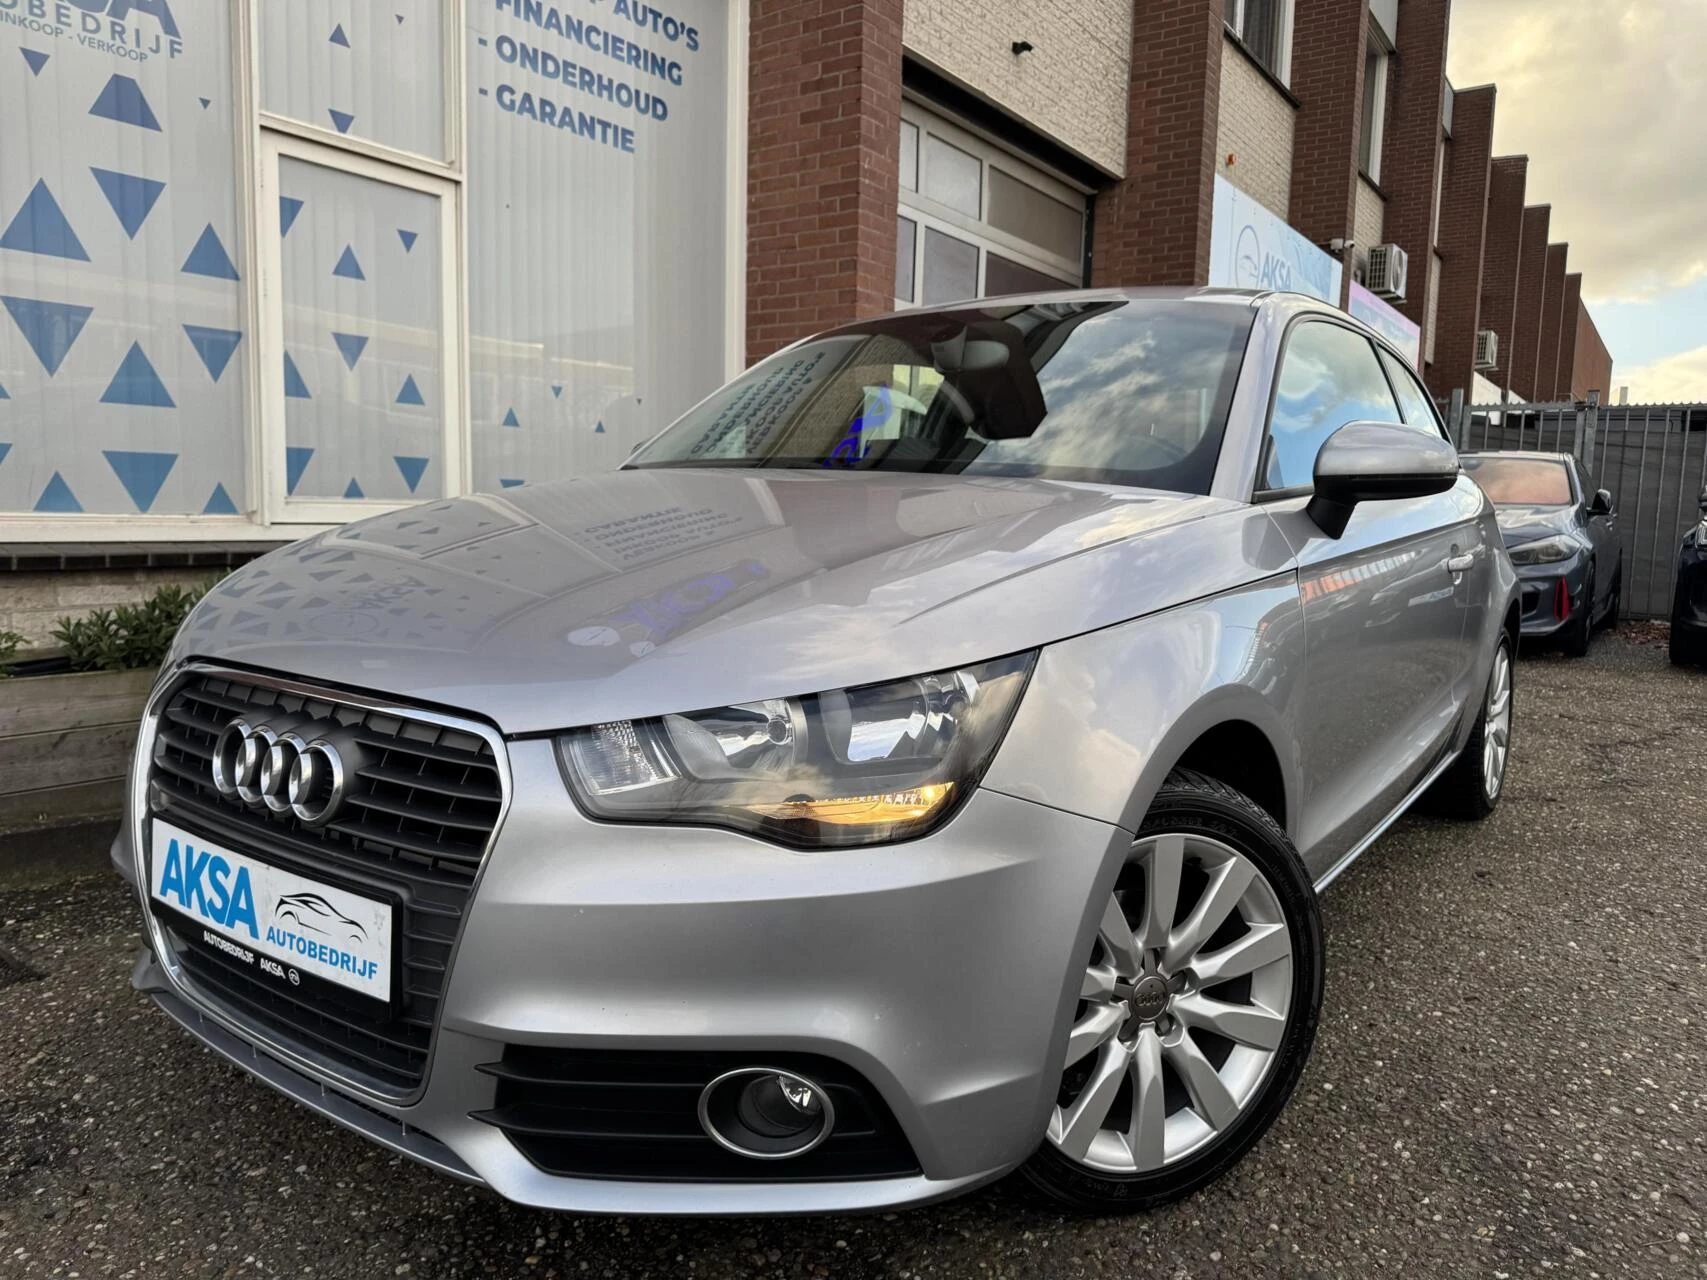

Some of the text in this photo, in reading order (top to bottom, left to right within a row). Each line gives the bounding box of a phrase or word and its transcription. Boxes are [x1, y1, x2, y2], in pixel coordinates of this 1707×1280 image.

[0, 10, 64, 38] INKOOP
[76, 33, 149, 63] VERKOOP
[613, 0, 700, 51] AUTO'S
[496, 35, 668, 121] ONDERHOUD
[496, 84, 635, 153] GARANTIE
[1260, 250, 1292, 291] AKSA
[160, 838, 259, 940] AKSA
[203, 930, 286, 980] AUTOBEDRIJF AKSA
[266, 926, 378, 980] AUTOBEDRIJF
